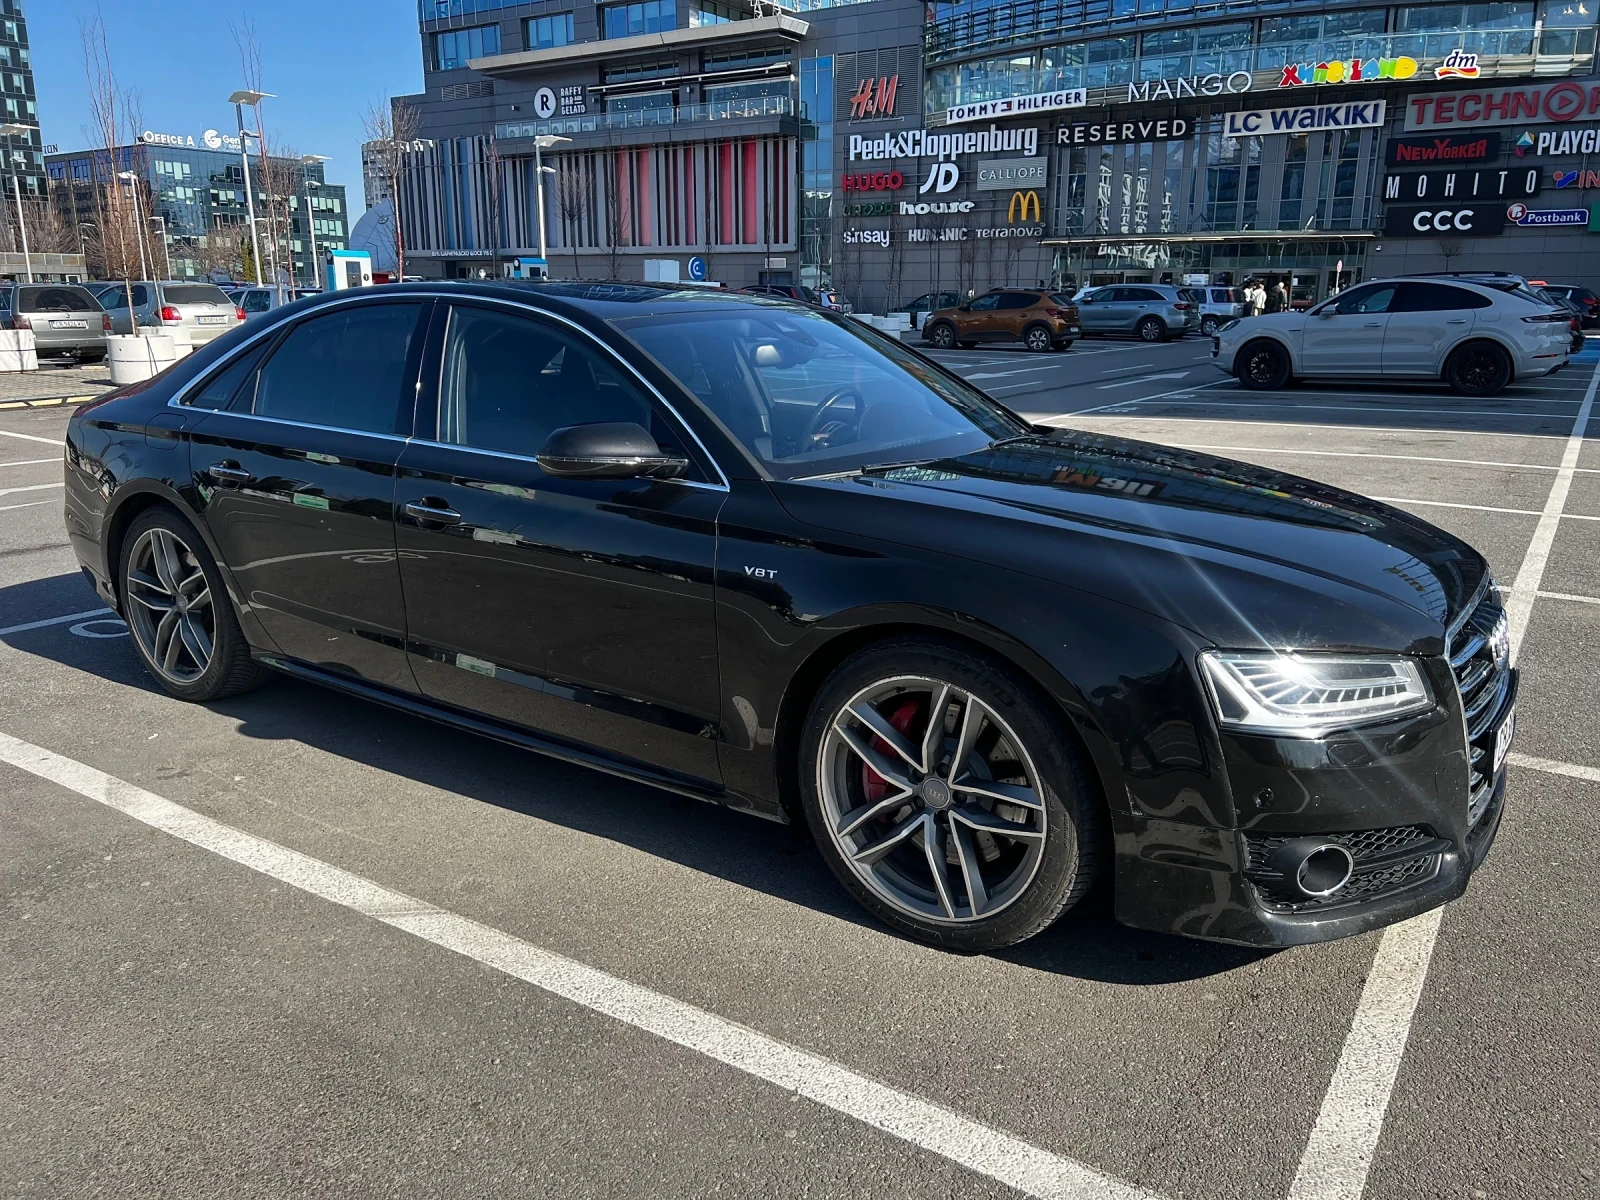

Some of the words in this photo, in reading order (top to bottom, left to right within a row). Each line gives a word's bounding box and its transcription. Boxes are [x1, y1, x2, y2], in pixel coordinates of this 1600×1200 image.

[1445, 50, 1476, 68] dm
[560, 86, 582, 97] RAFFY
[850, 75, 898, 117] H&M
[1128, 71, 1252, 103] MANGO
[560, 96, 574, 106] BAR
[561, 105, 586, 115] GELATO
[948, 103, 998, 120] TOMMY
[1017, 92, 1082, 110] HILFIGER
[1058, 120, 1187, 144] RESERVED
[1229, 112, 1262, 134] LC
[143, 130, 184, 145] OFFICE
[187, 135, 195, 146] A
[842, 170, 904, 193] HUGO
[919, 162, 960, 194] JD
[979, 166, 1044, 182] CALLIOPE
[1386, 170, 1537, 199] MOHITO
[899, 200, 975, 215] house
[1413, 210, 1475, 232] CCC
[1527, 212, 1581, 225] Postbank
[843, 227, 890, 248] sinsay
[908, 227, 968, 242] HUMANIC
[744, 565, 778, 579] V8T
